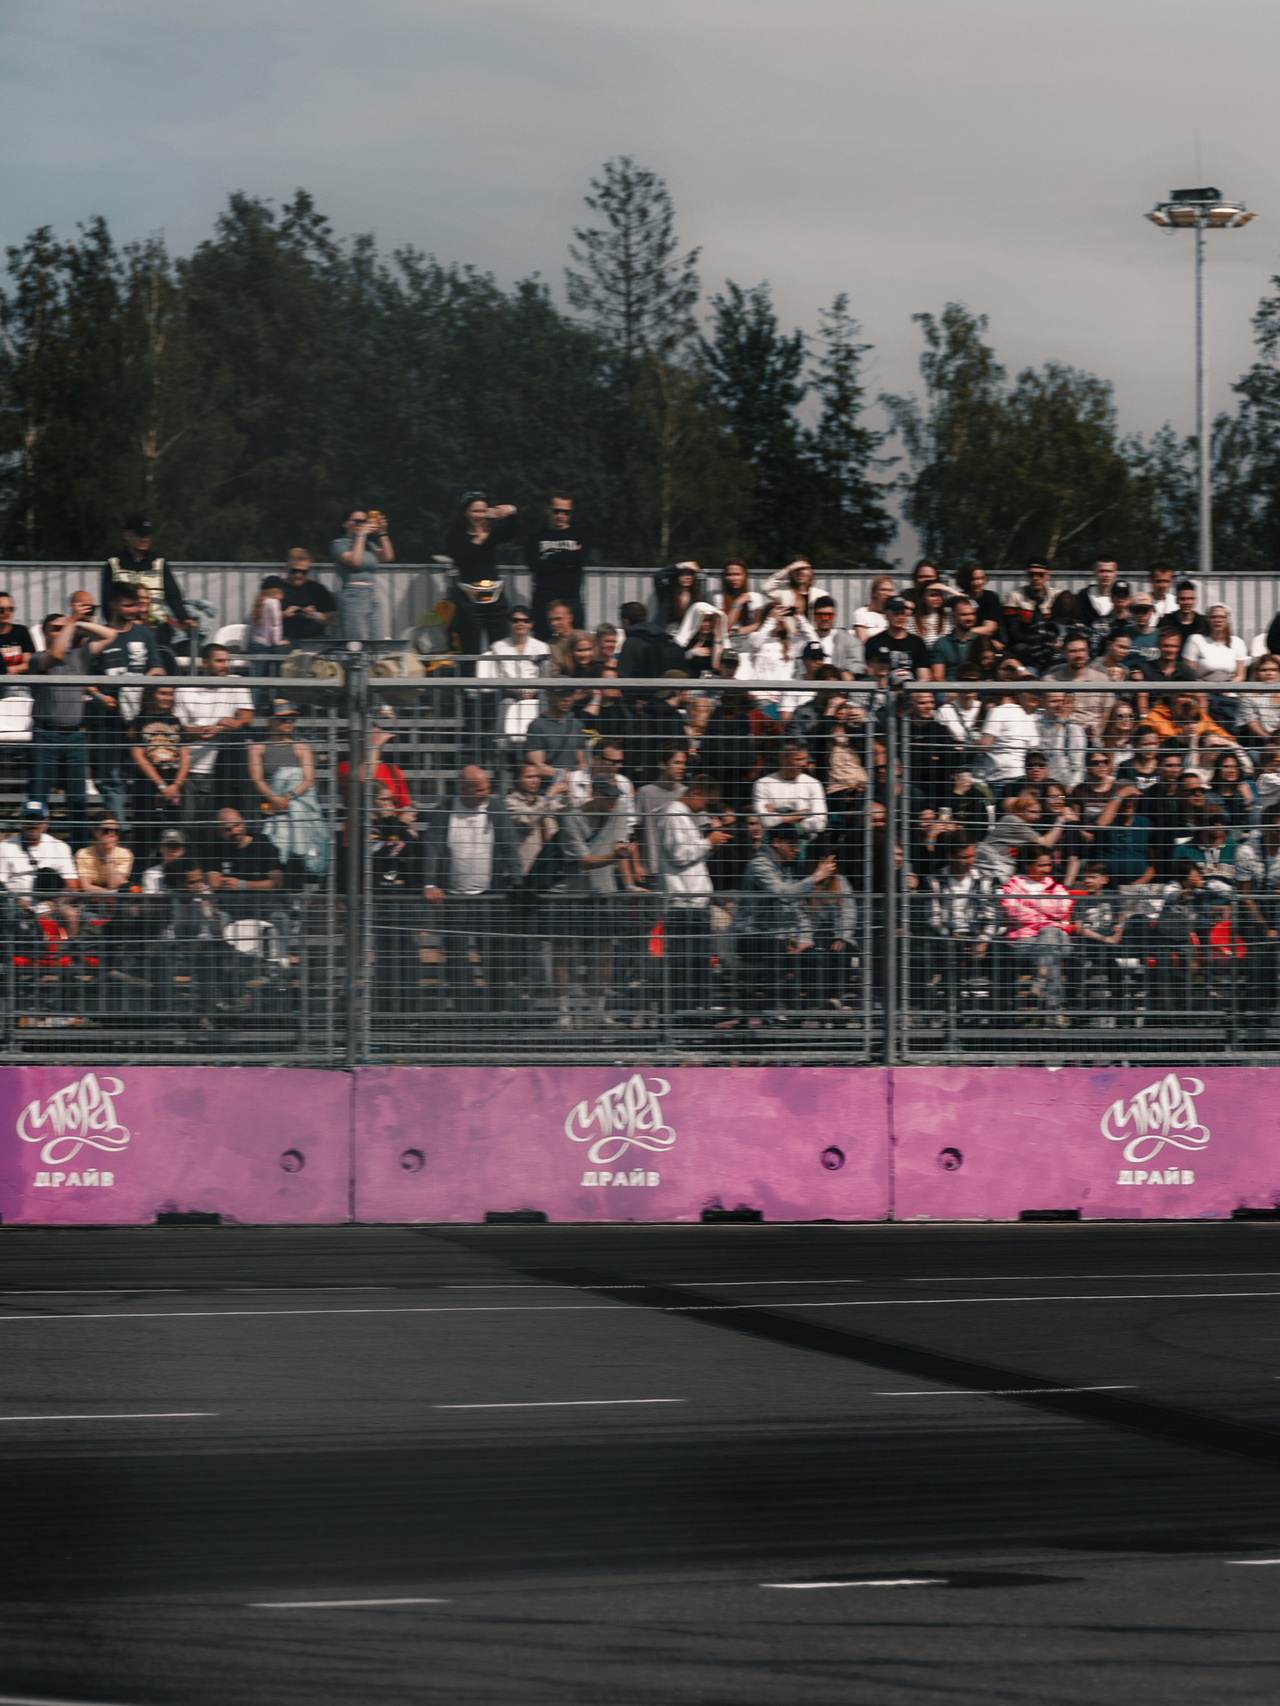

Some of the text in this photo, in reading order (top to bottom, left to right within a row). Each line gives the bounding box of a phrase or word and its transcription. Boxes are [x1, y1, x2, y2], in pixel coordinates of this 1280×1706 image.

[32, 1167, 115, 1187] ДРАЙВ
[580, 1167, 660, 1187] ДРАЙВ
[1116, 1166, 1195, 1185] ДРАЙВ
